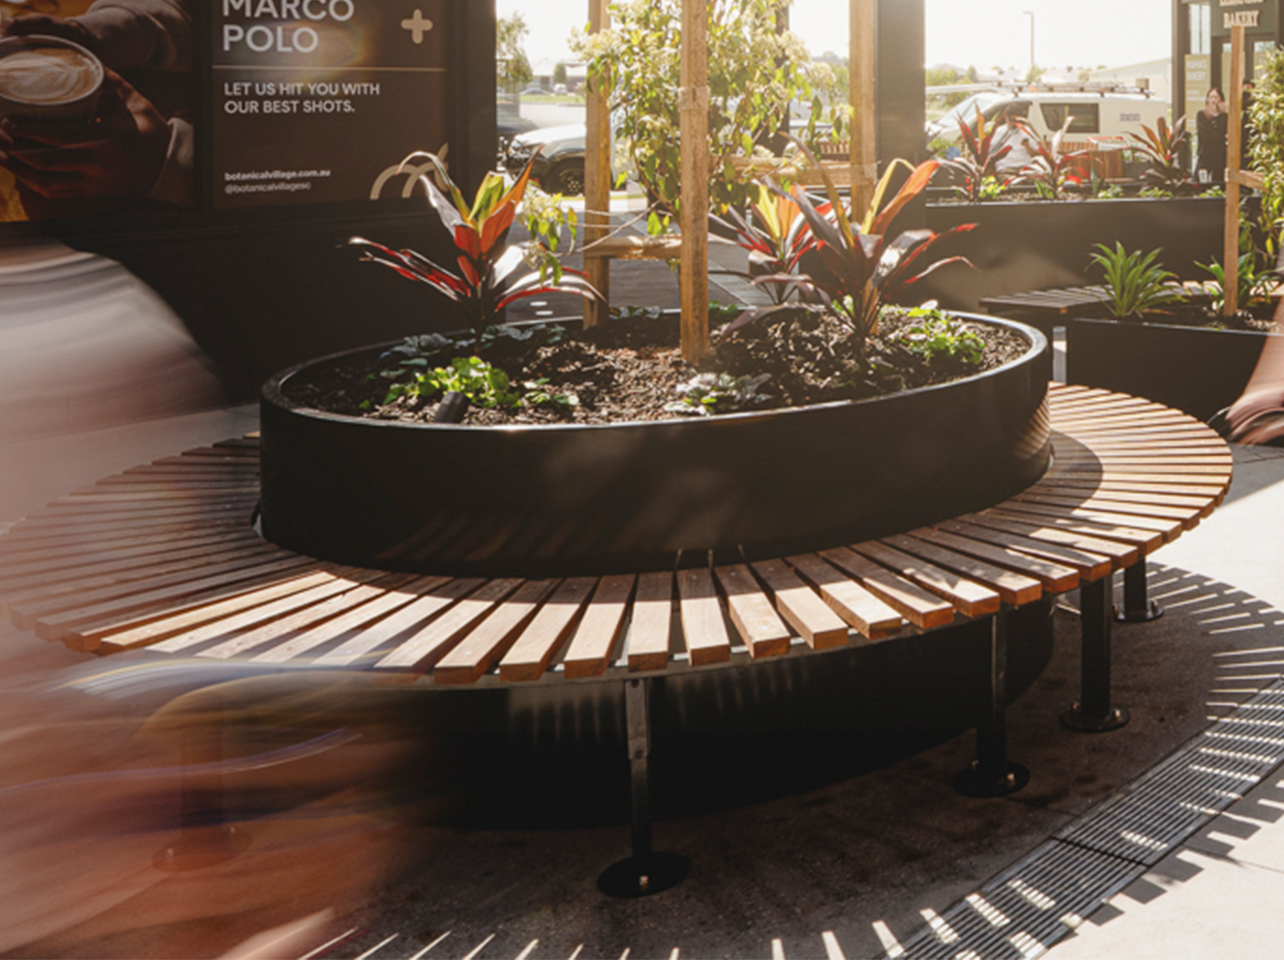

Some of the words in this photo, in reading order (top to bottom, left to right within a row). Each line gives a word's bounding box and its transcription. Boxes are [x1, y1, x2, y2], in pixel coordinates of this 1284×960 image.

[1223, 9, 1260, 29] BAKERY
[223, 24, 319, 53] POLO
[224, 82, 251, 96] LET
[255, 82, 276, 96] US
[279, 82, 304, 96] HIT
[307, 82, 339, 95] YOU
[342, 82, 380, 95] WITH
[224, 100, 259, 114] OUR
[263, 100, 299, 113] BEST
[302, 99, 355, 113] SHOTS.
[224, 169, 331, 181] botanicalvillage.com.au
